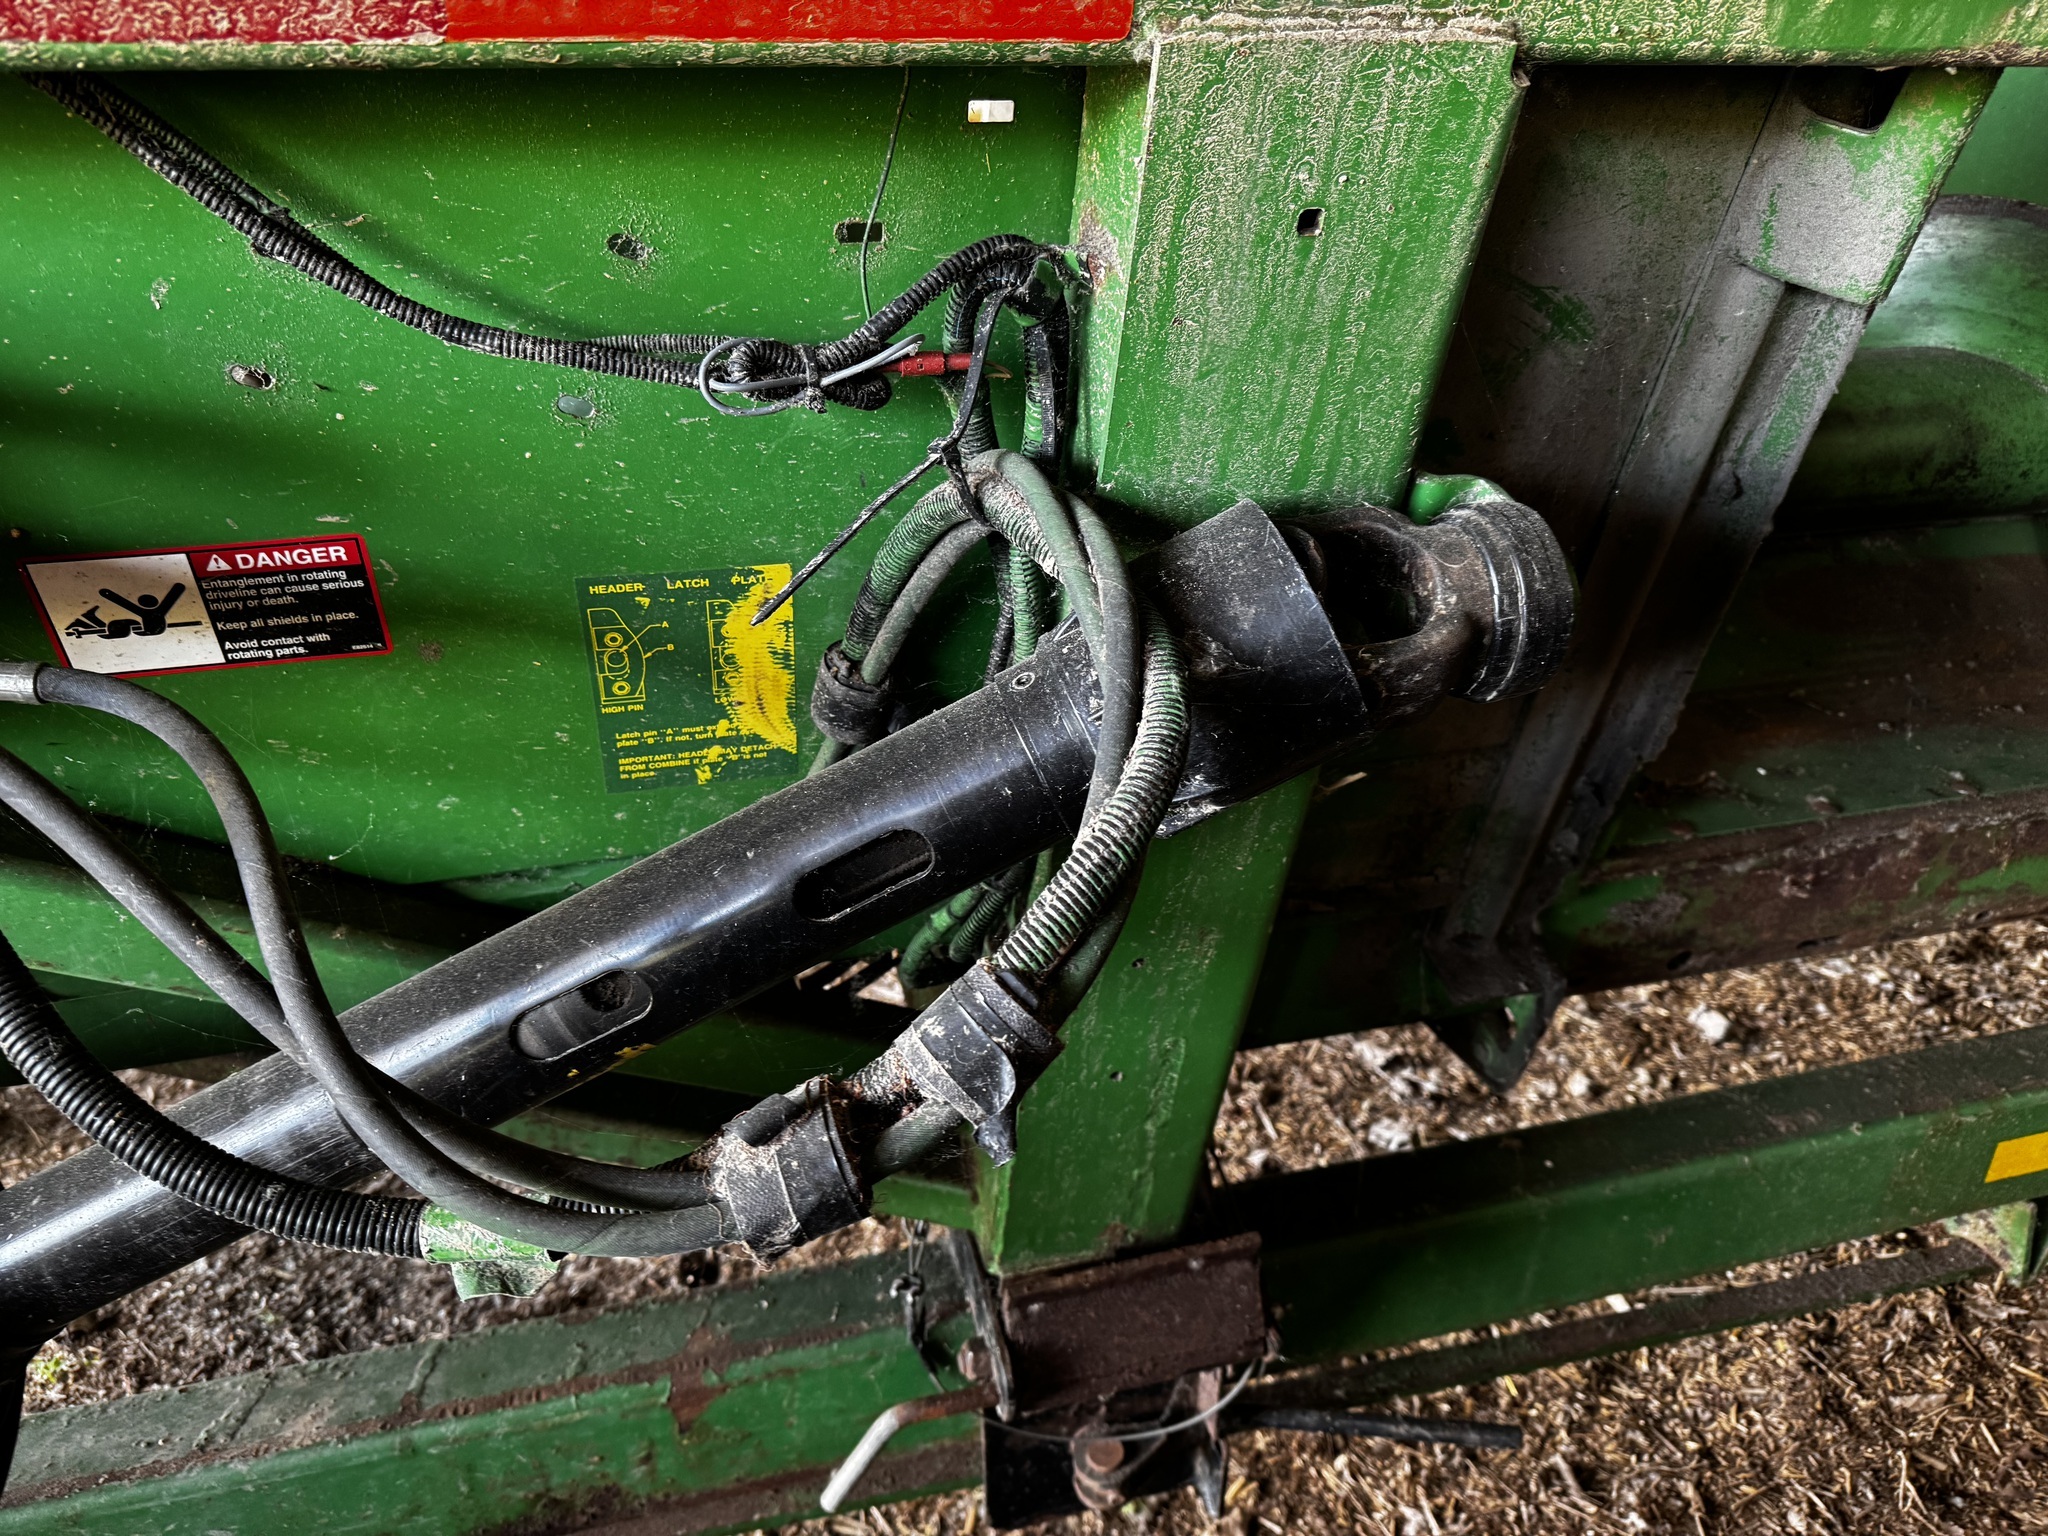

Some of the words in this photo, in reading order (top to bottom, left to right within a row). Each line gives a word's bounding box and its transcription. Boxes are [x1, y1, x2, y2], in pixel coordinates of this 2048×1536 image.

[234, 546, 348, 570] DANGER
[202, 574, 285, 590] Entanglement
[287, 573, 299, 582] in
[301, 570, 347, 582] rotating
[590, 583, 644, 594] HEADER
[666, 578, 710, 590] LATCH
[730, 574, 774, 585] PLAT
[206, 584, 258, 600] driveline
[260, 586, 282, 596] can
[284, 583, 320, 594] cause
[322, 579, 365, 590] serious
[209, 599, 244, 612] injury
[246, 599, 259, 608] or
[262, 595, 299, 606] death.
[216, 618, 248, 632] Keep
[250, 617, 264, 628] all
[267, 614, 309, 626] shields
[312, 613, 323, 622] in
[326, 611, 360, 625] place.
[224, 636, 258, 650] Avoid
[260, 635, 304, 648] contact
[306, 632, 331, 643] with
[227, 648, 274, 661] rotating
[276, 646, 309, 658] parts.
[601, 706, 626, 714] HIGH
[628, 704, 644, 712] PIN
[616, 731, 640, 740] Latch
[616, 739, 638, 748] plate
[618, 753, 676, 764] IMPORTANT:
[678, 748, 716, 758] HEADE
[620, 764, 646, 772] FROM
[648, 759, 690, 769] COMBINE
